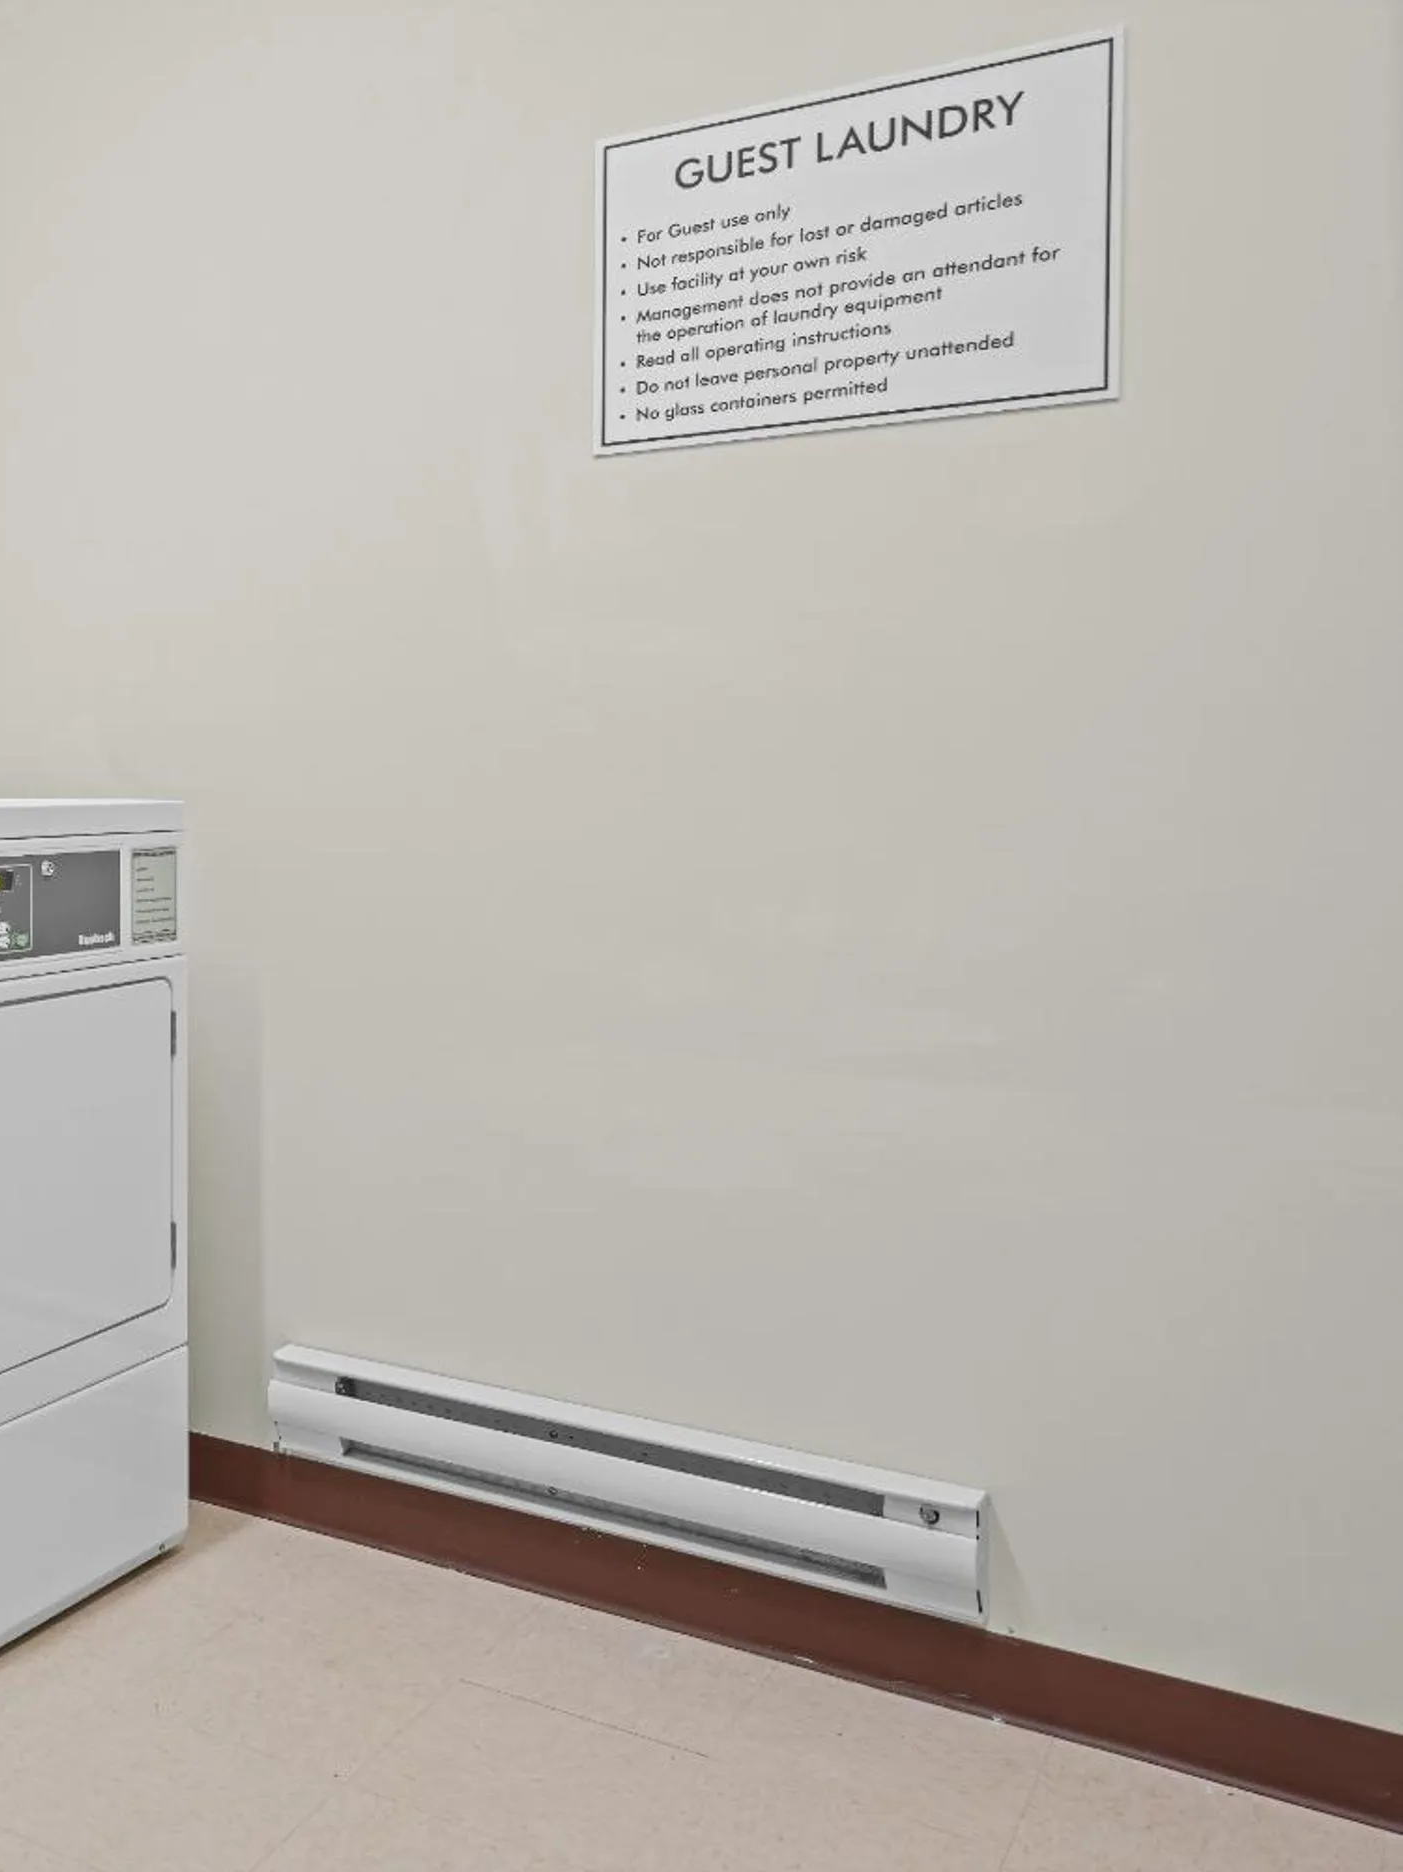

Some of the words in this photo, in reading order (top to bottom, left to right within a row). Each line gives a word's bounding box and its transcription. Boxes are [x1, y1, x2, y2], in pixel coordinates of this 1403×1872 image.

[674, 135, 802, 190] GUEST
[816, 89, 1025, 164] LAUNDRY
[636, 228, 664, 245] For
[666, 217, 716, 239] Guest
[719, 213, 750, 229] use
[753, 202, 791, 223] only
[636, 253, 667, 270] Not
[670, 236, 765, 265] responsible
[769, 230, 794, 248] for
[799, 225, 830, 243] lost
[834, 222, 855, 237] or
[859, 201, 948, 233] damaged
[953, 192, 1023, 216] articles
[635, 294, 744, 325] Management
[748, 289, 789, 306] does
[794, 282, 823, 299] not
[828, 269, 896, 298] provide
[901, 269, 926, 284] an
[931, 250, 1026, 278] attendant
[1030, 245, 1061, 263] for
[636, 281, 667, 297] Use
[670, 271, 724, 291] facility
[727, 266, 745, 282] at
[748, 262, 789, 283] your
[792, 255, 830, 272] own
[835, 245, 868, 265] risk
[635, 328, 662, 344] the
[665, 316, 744, 342] operation
[749, 309, 768, 327] of
[772, 301, 839, 325] laundry
[843, 286, 943, 315] equipment
[635, 348, 675, 369] Read
[679, 345, 699, 362] all
[704, 336, 786, 362] operating
[791, 322, 892, 347] instructions
[635, 379, 660, 396] Do
[663, 375, 690, 392] not
[694, 371, 739, 387] leave
[743, 357, 818, 385] personal
[823, 349, 901, 375] property
[904, 330, 1014, 360] unattended
[635, 406, 660, 422] No
[663, 402, 705, 422] glass
[709, 391, 798, 413] containers
[802, 376, 888, 405] permitted
